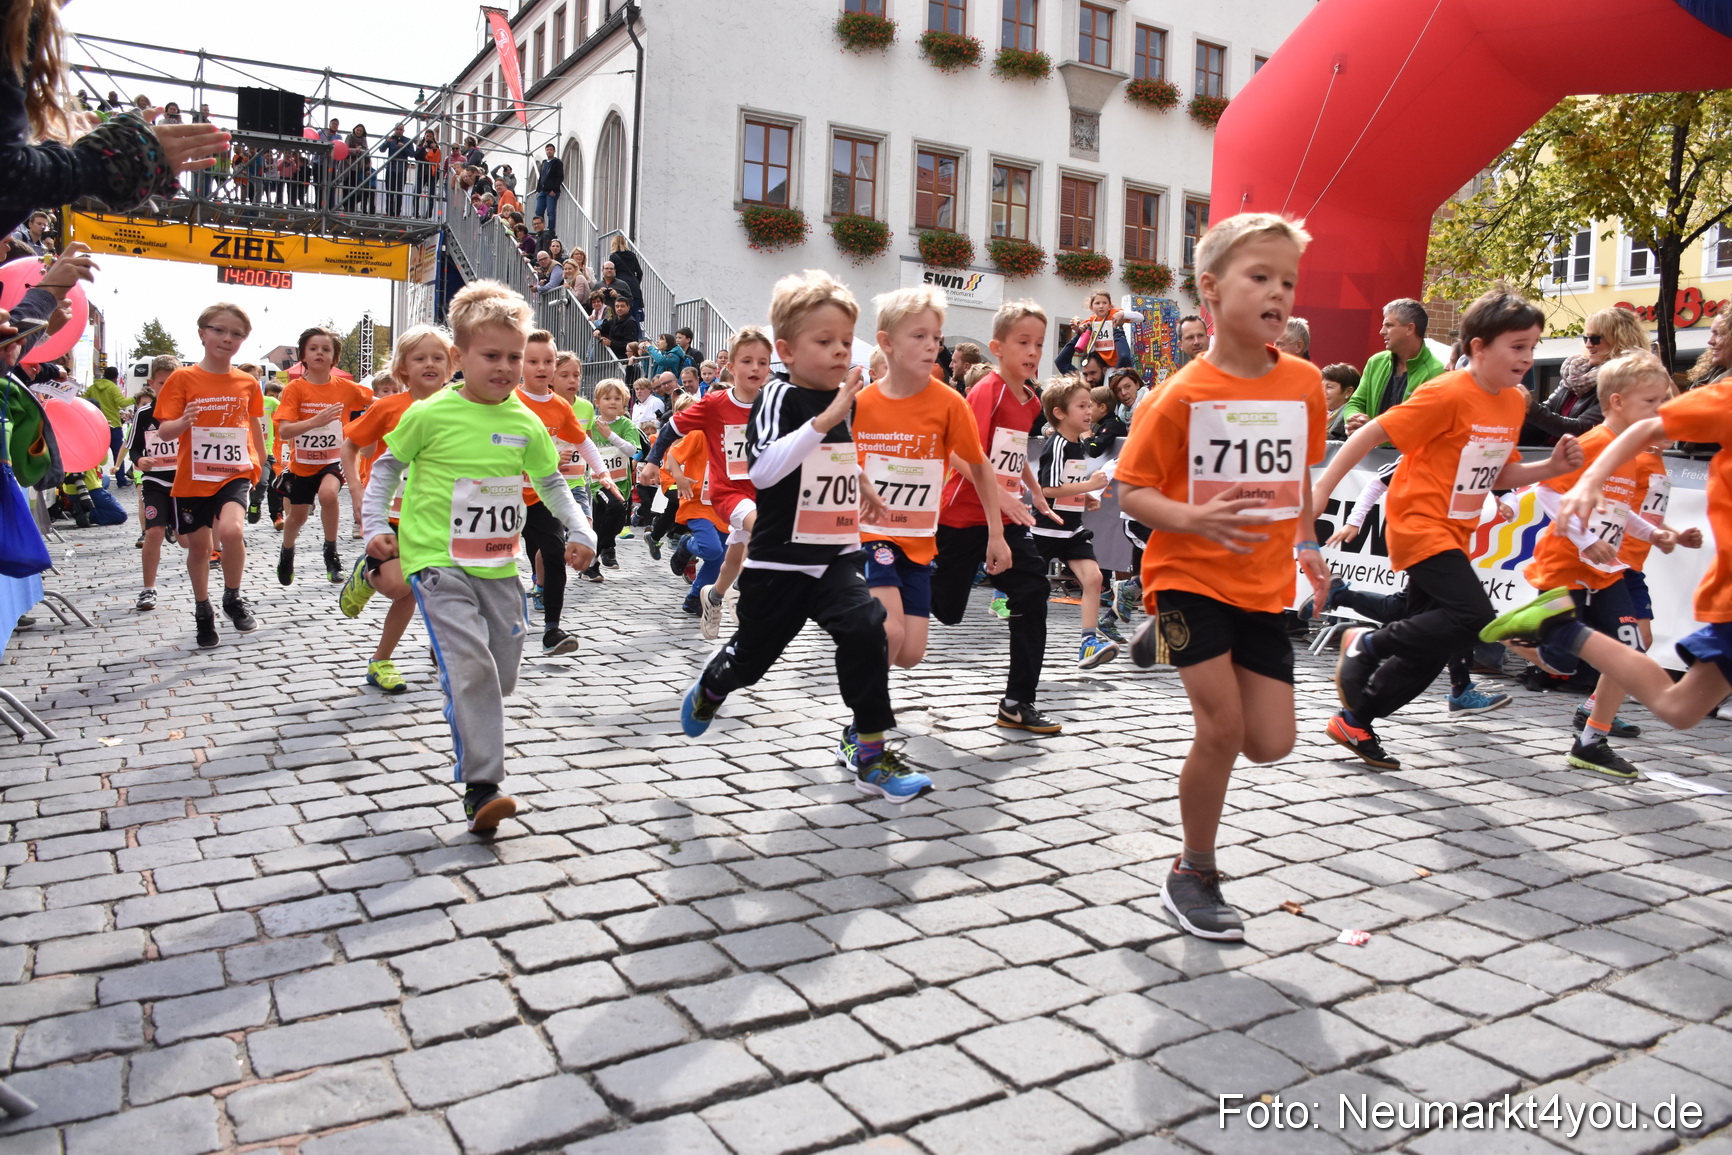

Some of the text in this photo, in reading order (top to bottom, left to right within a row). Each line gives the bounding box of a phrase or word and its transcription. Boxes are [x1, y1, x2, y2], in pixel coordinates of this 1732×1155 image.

[210, 235, 285, 263] ZIEL
[198, 404, 229, 412] tadtlauf
[301, 435, 336, 448] 7232
[857, 432, 914, 441] Neumarkter
[152, 442, 180, 455] 701
[201, 444, 242, 461] 7135
[857, 443, 902, 454] Stadtlauf
[1209, 439, 1292, 474] 7165
[875, 480, 931, 507] 7777
[836, 516, 854, 527] Max
[890, 514, 907, 523] Luis
[485, 542, 512, 553] Georg
